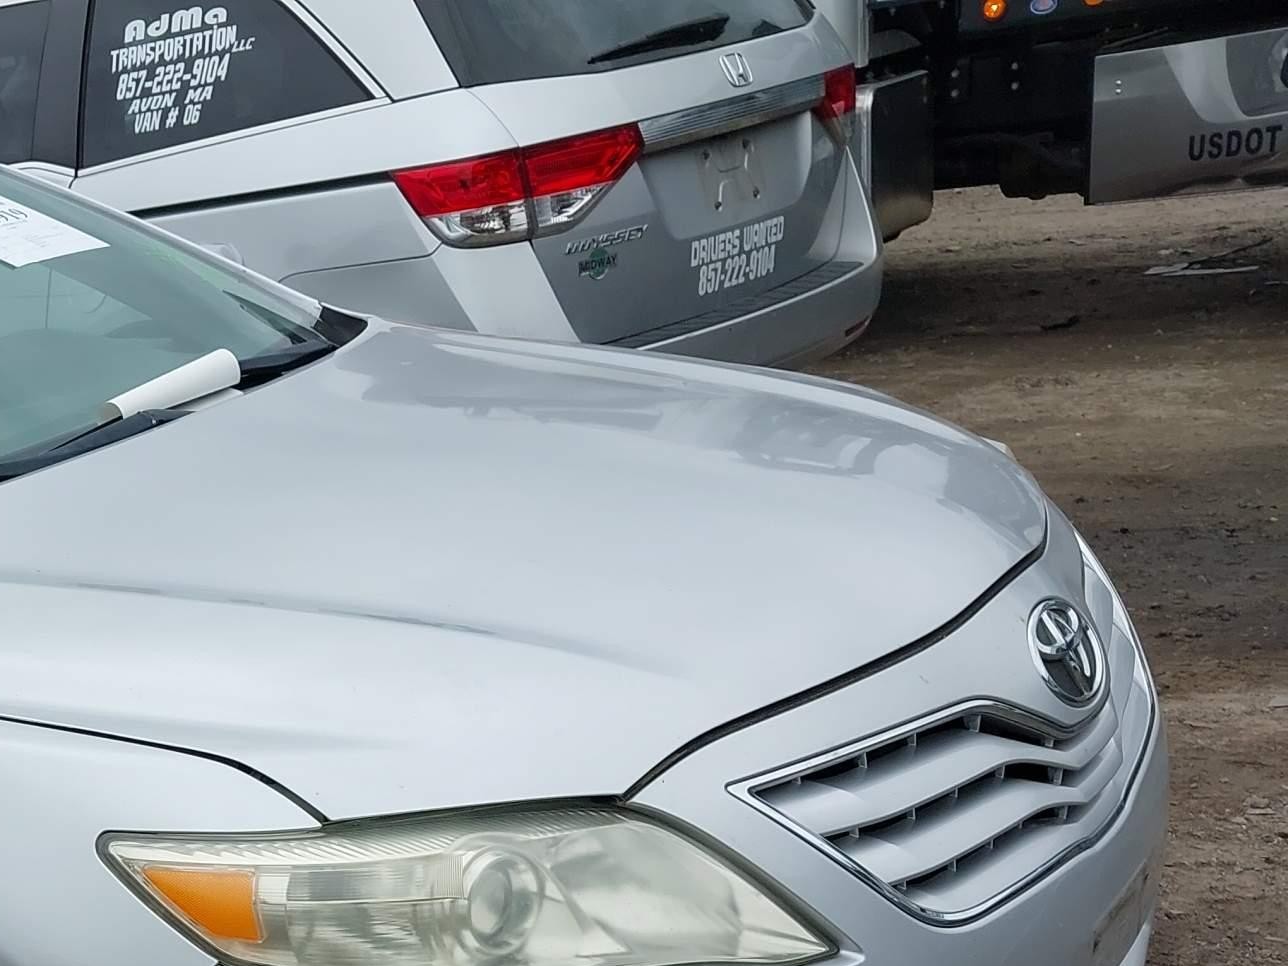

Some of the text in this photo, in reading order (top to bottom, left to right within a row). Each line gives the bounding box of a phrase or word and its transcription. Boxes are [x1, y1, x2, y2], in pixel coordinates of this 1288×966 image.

[232, 37, 256, 53] LLC
[116, 53, 231, 101] 857-222-9104
[184, 85, 214, 104] MA
[134, 104, 202, 134] VAN # 06
[1188, 125, 1282, 161] USDOT
[691, 215, 784, 267] DRIVERS WANTED
[698, 244, 775, 297] 857-222-9104
